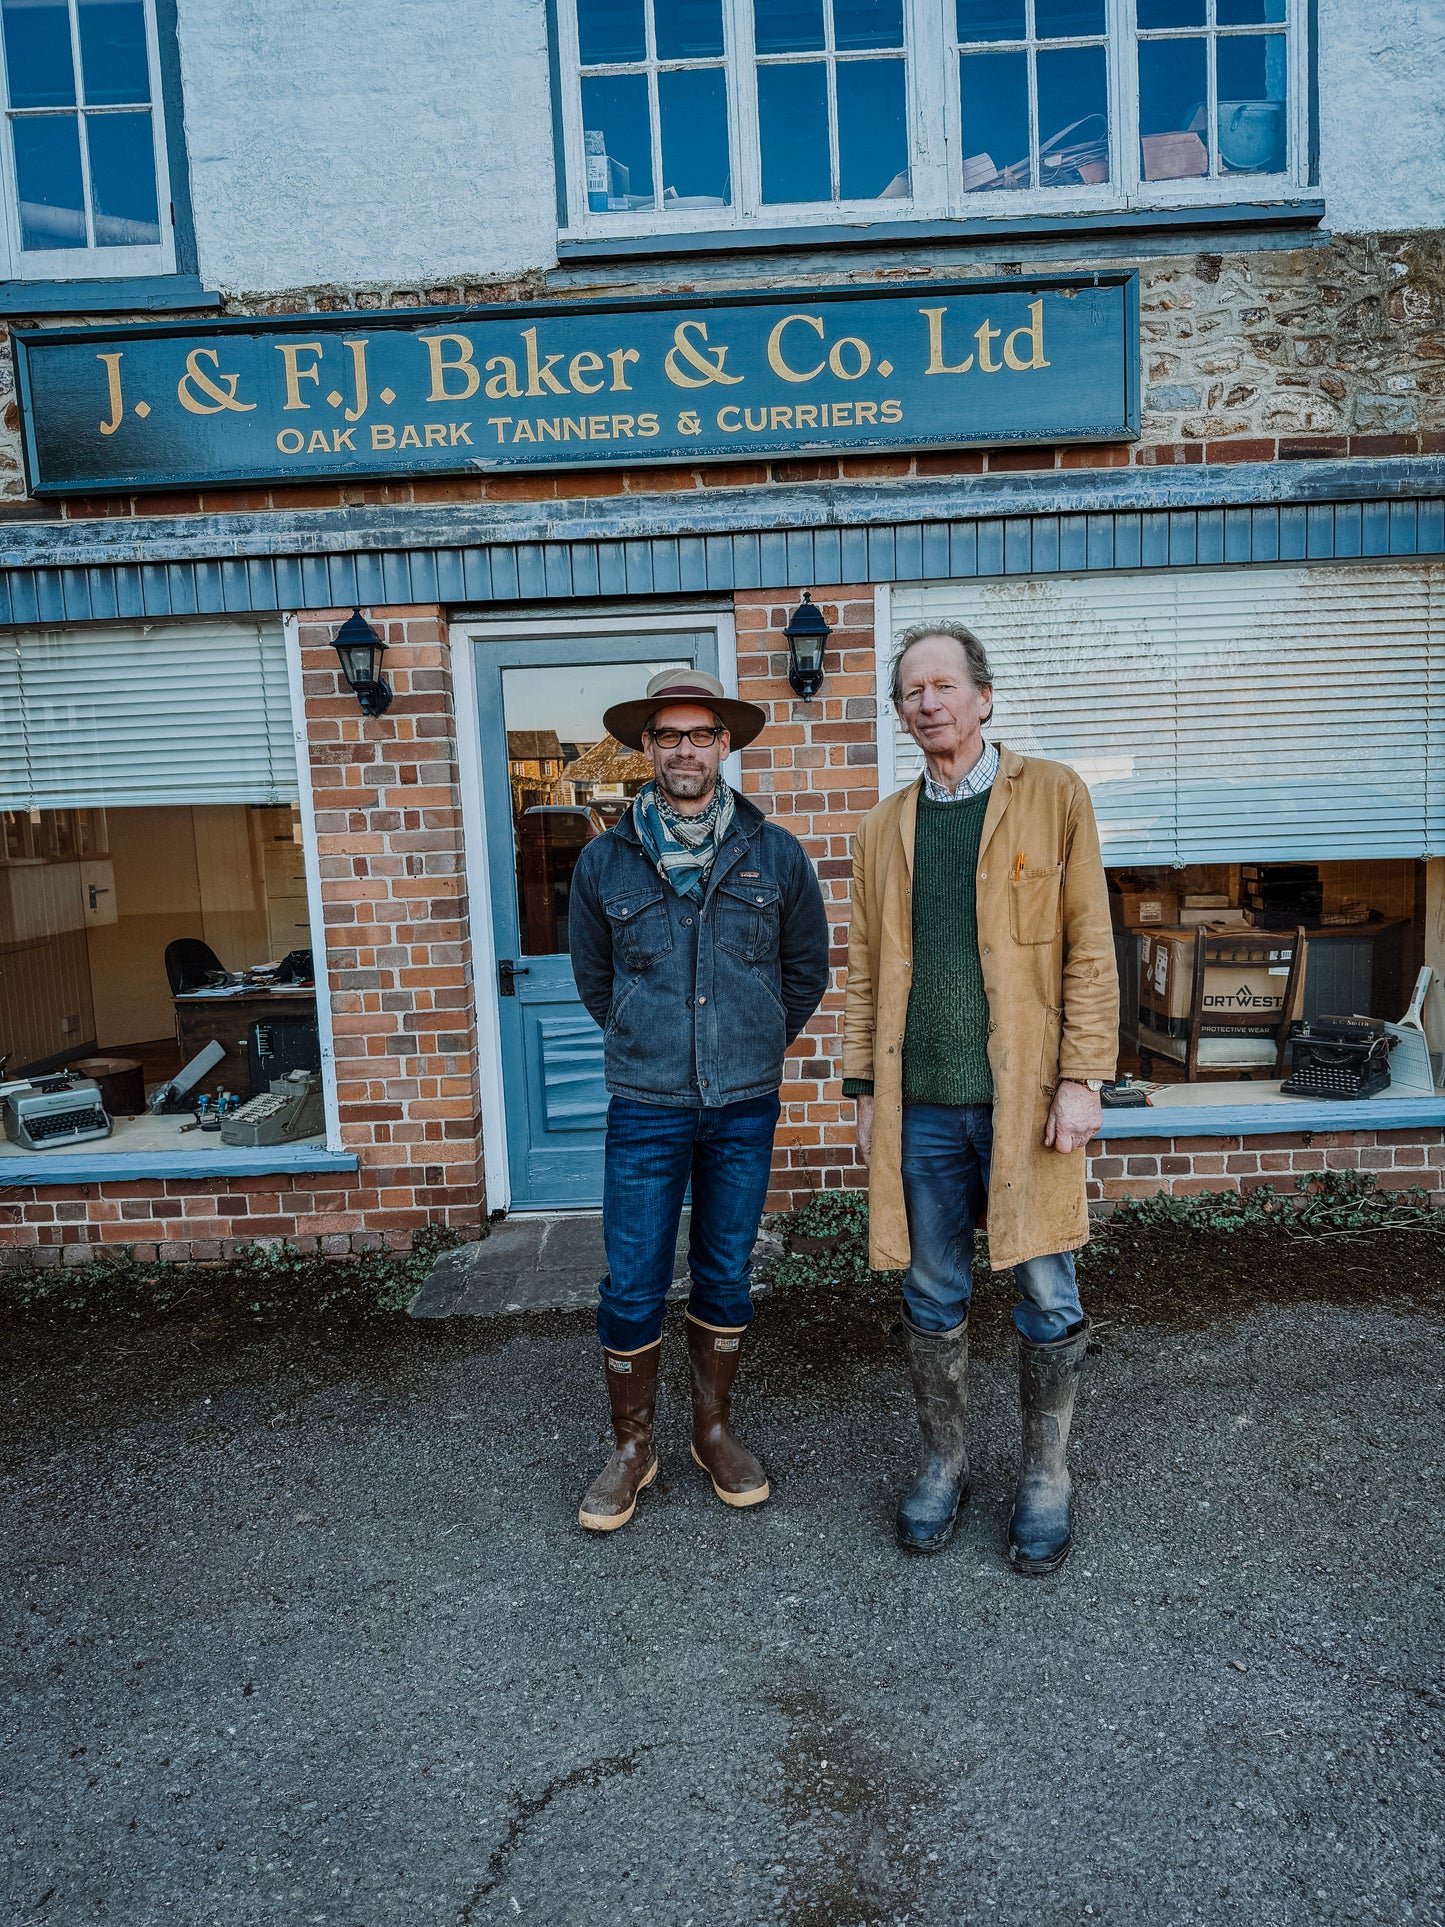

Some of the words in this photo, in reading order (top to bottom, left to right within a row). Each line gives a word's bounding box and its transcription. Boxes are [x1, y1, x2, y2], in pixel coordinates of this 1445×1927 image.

[96, 352, 151, 436] J.
[177, 348, 257, 415] &
[274, 339, 397, 422] F.J.
[418, 327, 640, 403] Baker
[664, 320, 744, 389] &
[766, 314, 893, 383] Co.
[919, 298, 1051, 375] Ltd
[276, 427, 357, 455] OAK
[371, 421, 473, 451] BARK
[487, 411, 660, 444] TANNERS
[676, 410, 702, 436] &
[716, 399, 904, 433] CURRIERS
[1203, 995, 1283, 1008] ORTWEST
